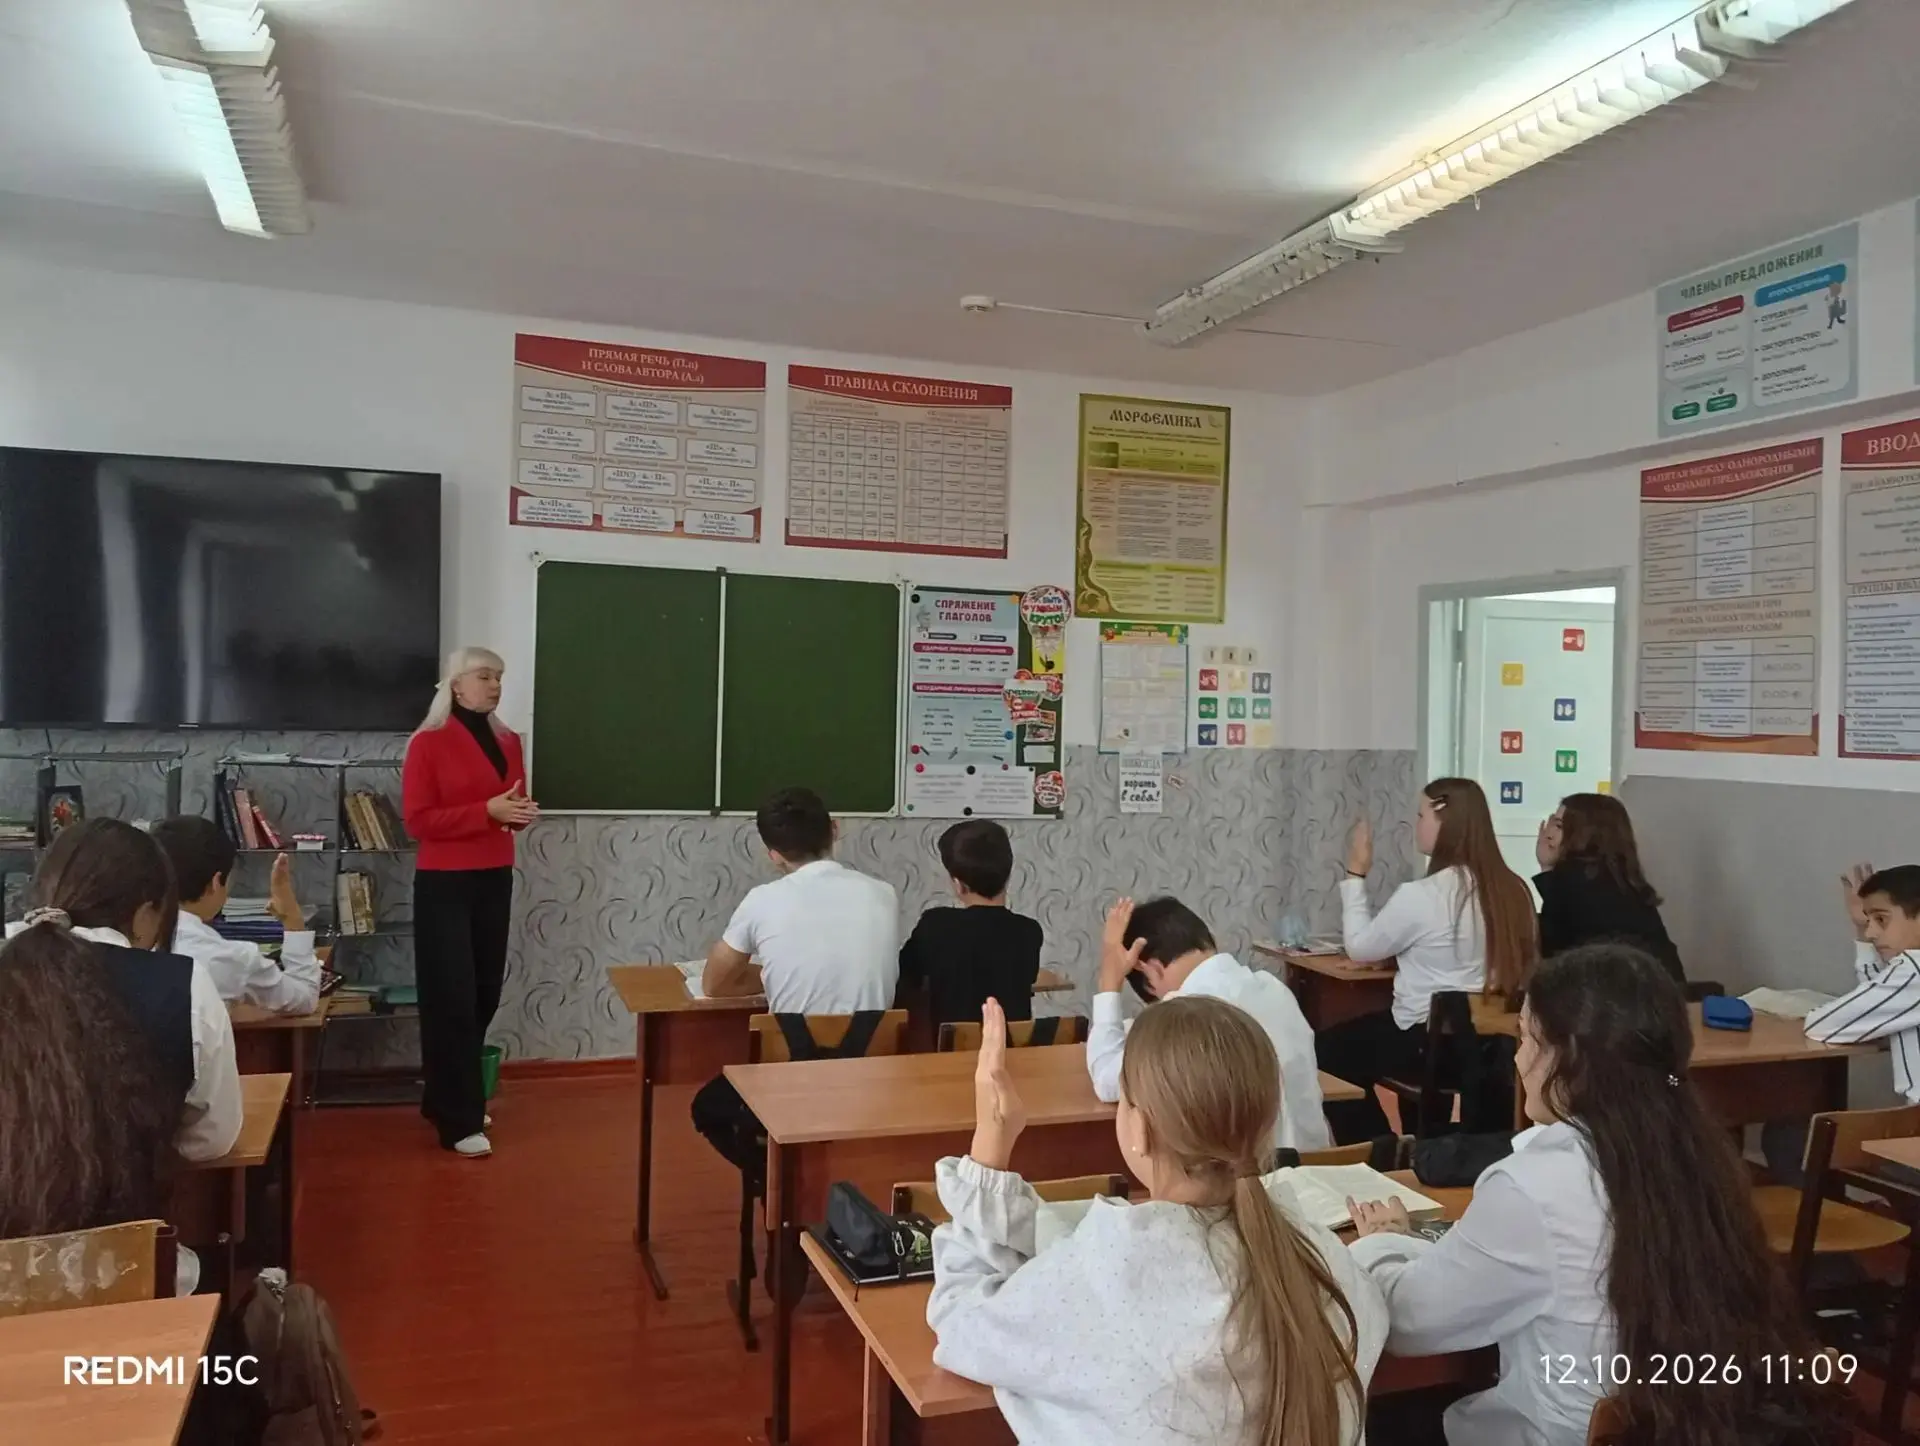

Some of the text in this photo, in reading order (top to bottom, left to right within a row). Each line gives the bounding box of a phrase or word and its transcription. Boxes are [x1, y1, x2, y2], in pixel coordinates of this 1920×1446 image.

[1680, 244, 1824, 299] ЧЛЕНЫ ПРЕДЛОЖЕНИЯ
[588, 348, 637, 363] ПРЯМАЯ
[640, 354, 670, 367] РЕЧЬ
[581, 361, 592, 370] И
[594, 362, 633, 375] СЛОВА
[634, 365, 679, 380] АВТОРА
[824, 375, 979, 401] ПРАВИЛА СКЛОНЕНИЯ
[1109, 409, 1202, 428] МОРФЕМИКА
[935, 599, 997, 611] СПРЯЖЕНИЕ
[938, 611, 993, 623] ГЛАГОЛОВ
[1129, 789, 1161, 802] себя!
